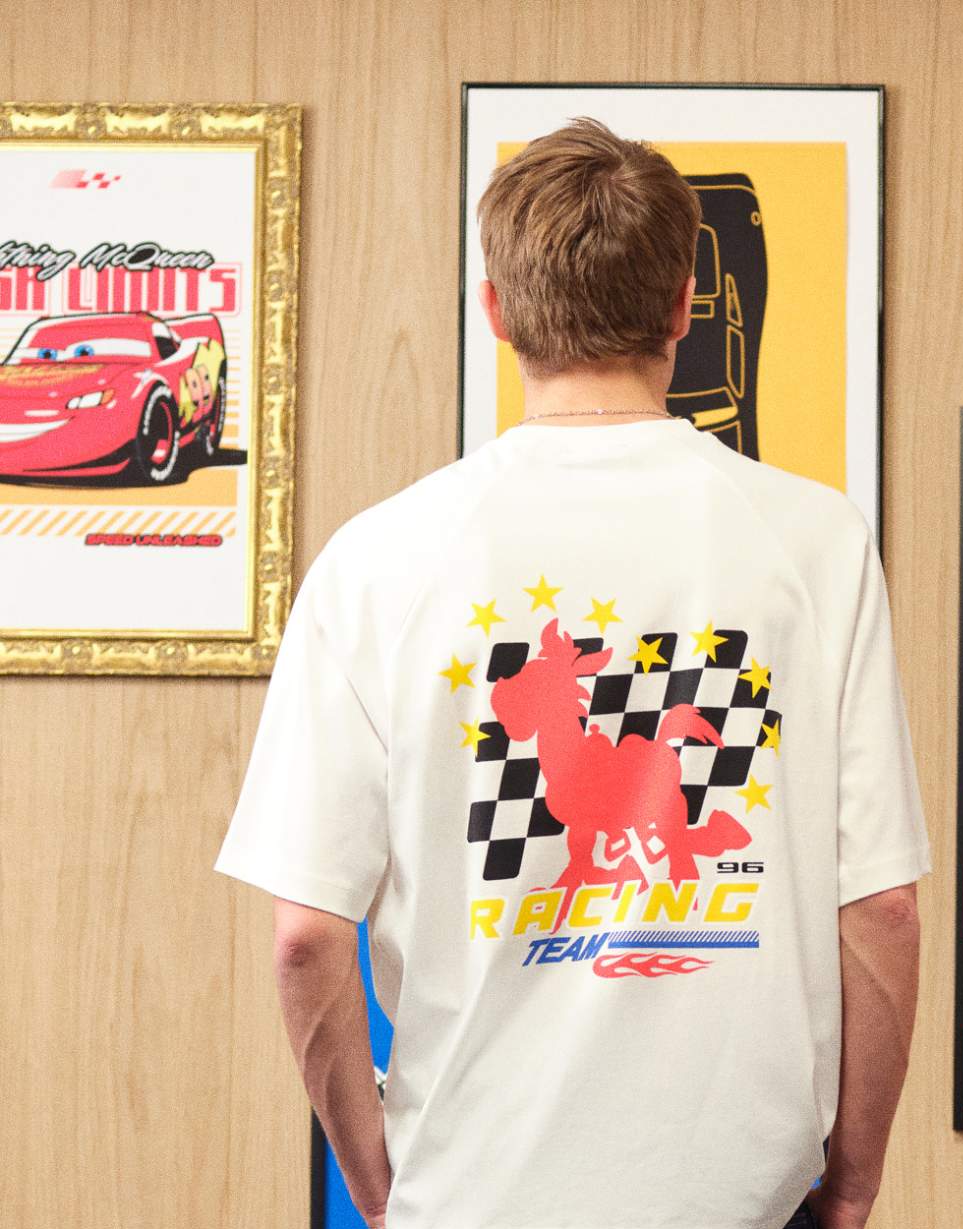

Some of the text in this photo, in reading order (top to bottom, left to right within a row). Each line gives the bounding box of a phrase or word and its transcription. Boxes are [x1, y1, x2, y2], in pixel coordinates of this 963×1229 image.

[80, 242, 215, 272] McQueen
[68, 266, 236, 313] LIMITS
[717, 861, 764, 874] 96
[469, 882, 760, 940] RACING
[522, 931, 611, 967] TEAM
